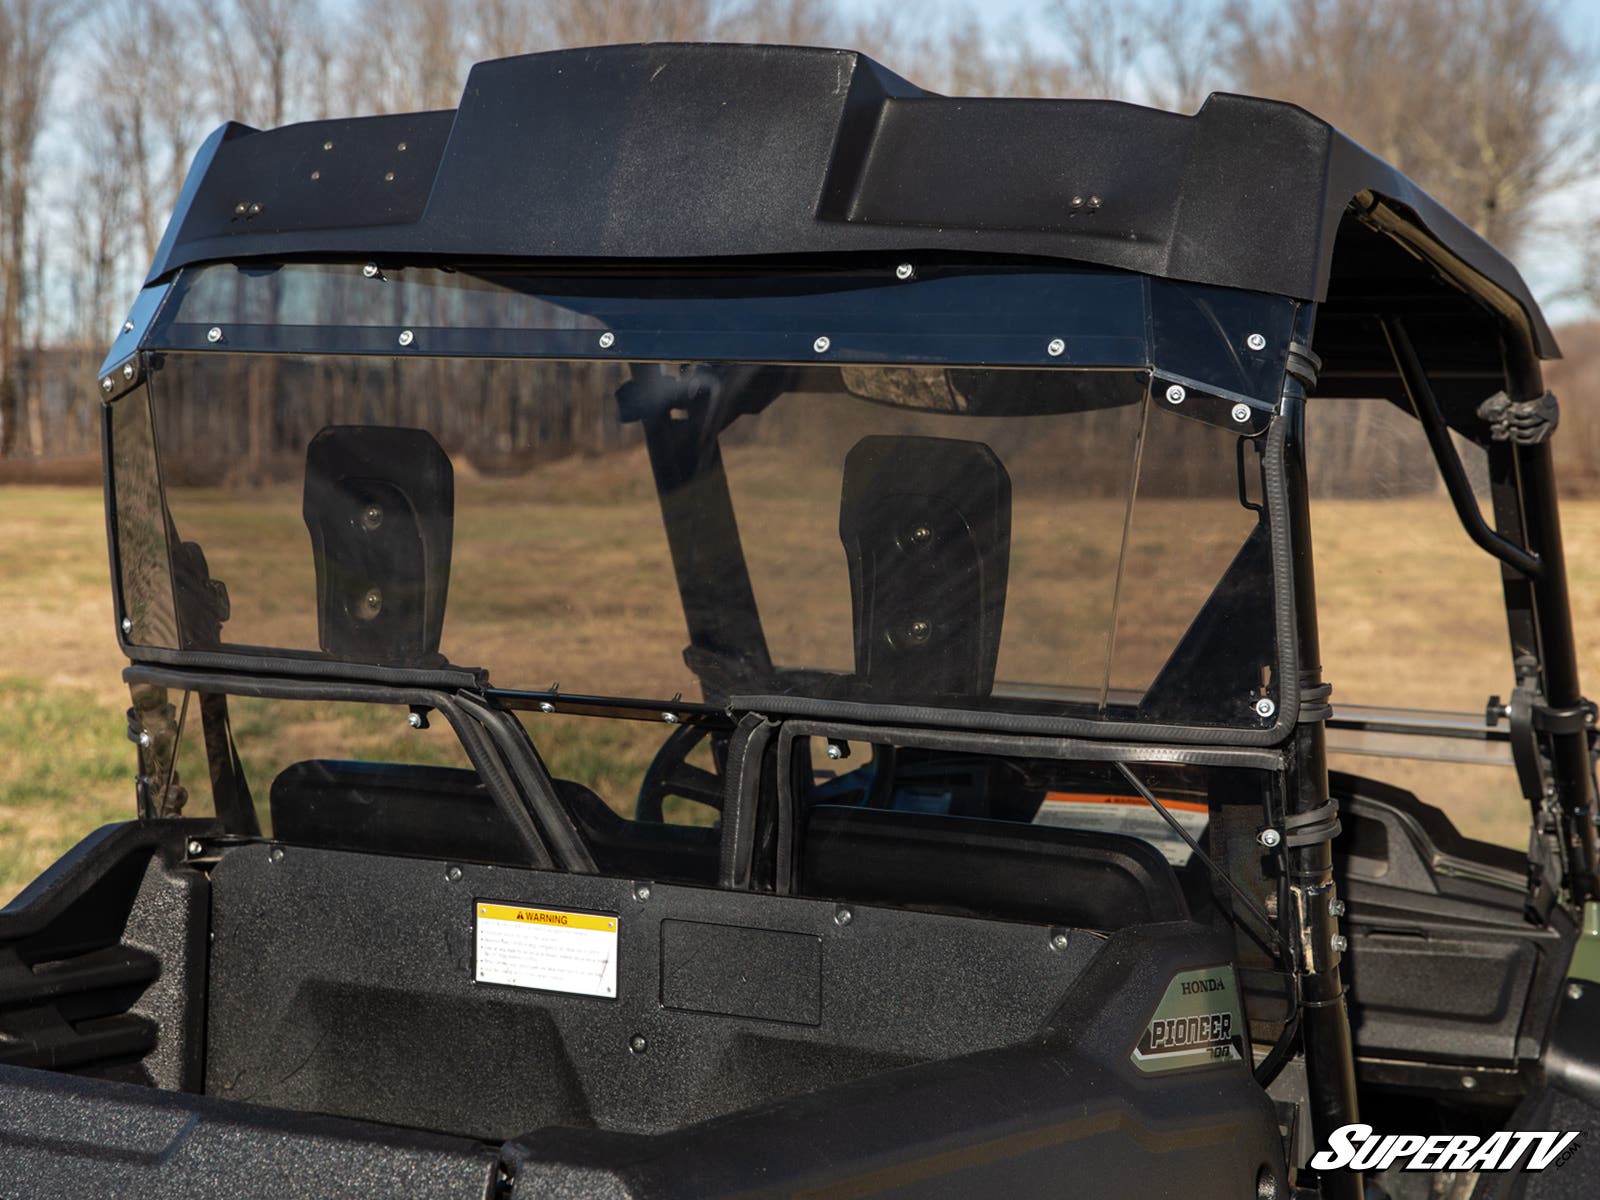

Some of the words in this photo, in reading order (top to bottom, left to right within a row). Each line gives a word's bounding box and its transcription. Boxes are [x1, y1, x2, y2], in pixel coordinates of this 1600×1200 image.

[525, 911, 568, 925] WARNING
[1181, 977, 1225, 995] HONDA
[1151, 1012, 1232, 1049] PIONEER
